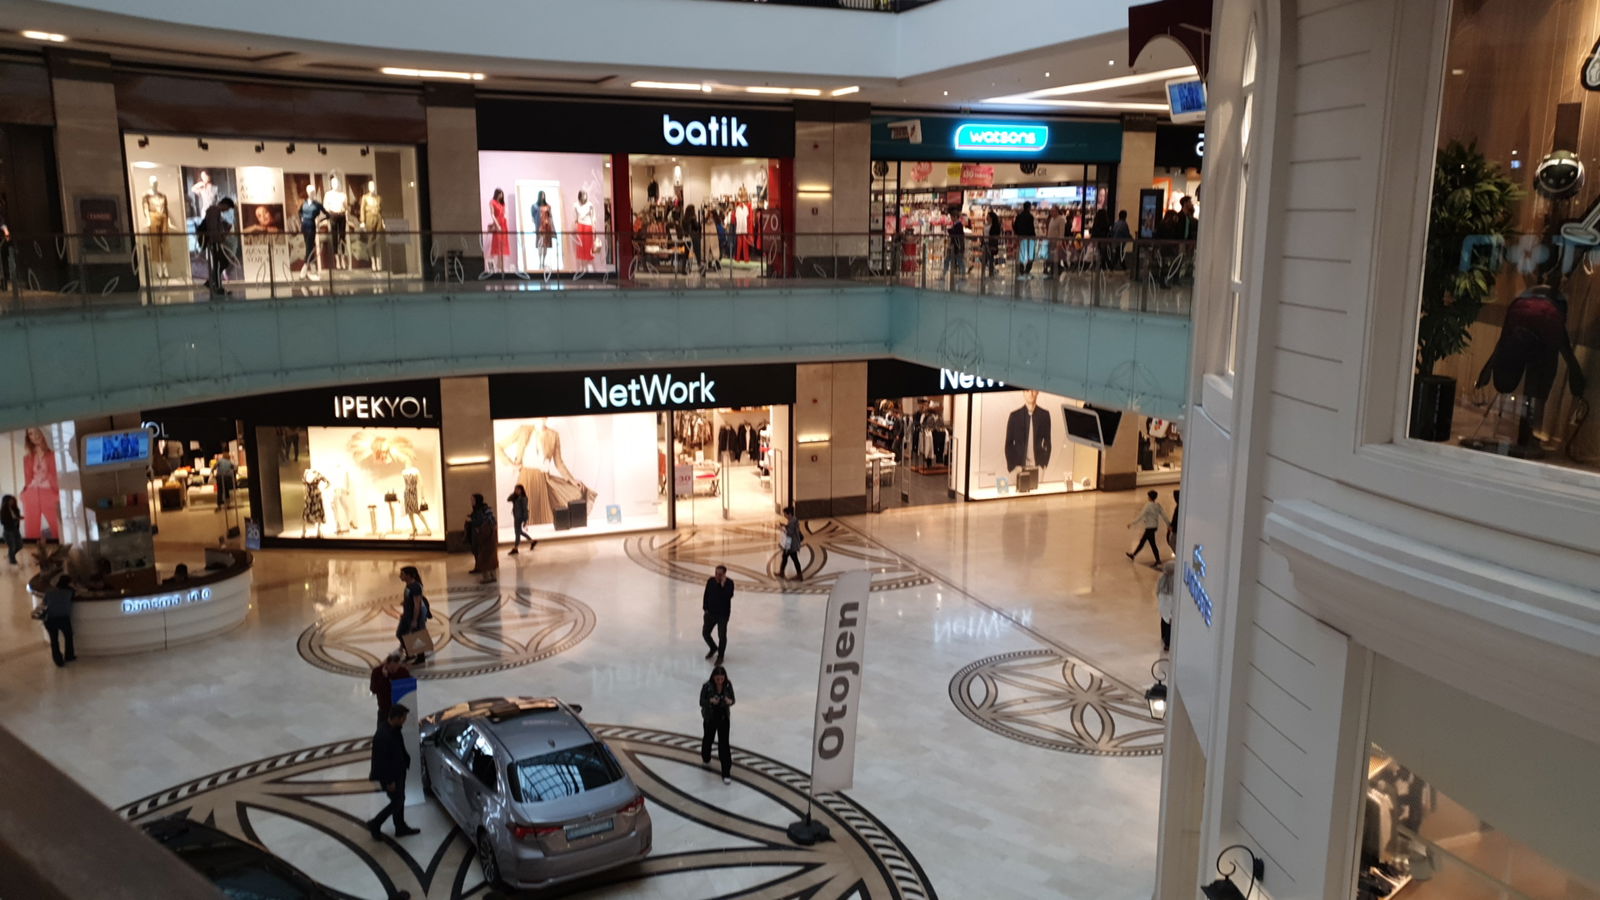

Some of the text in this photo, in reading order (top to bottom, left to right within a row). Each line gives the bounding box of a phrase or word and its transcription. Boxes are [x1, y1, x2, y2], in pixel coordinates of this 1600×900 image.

[663, 114, 749, 147] batik
[970, 131, 1037, 145] watsons
[334, 395, 433, 419] IPEKYOL
[583, 372, 716, 409] NetWork
[818, 601, 860, 761] Otojen
